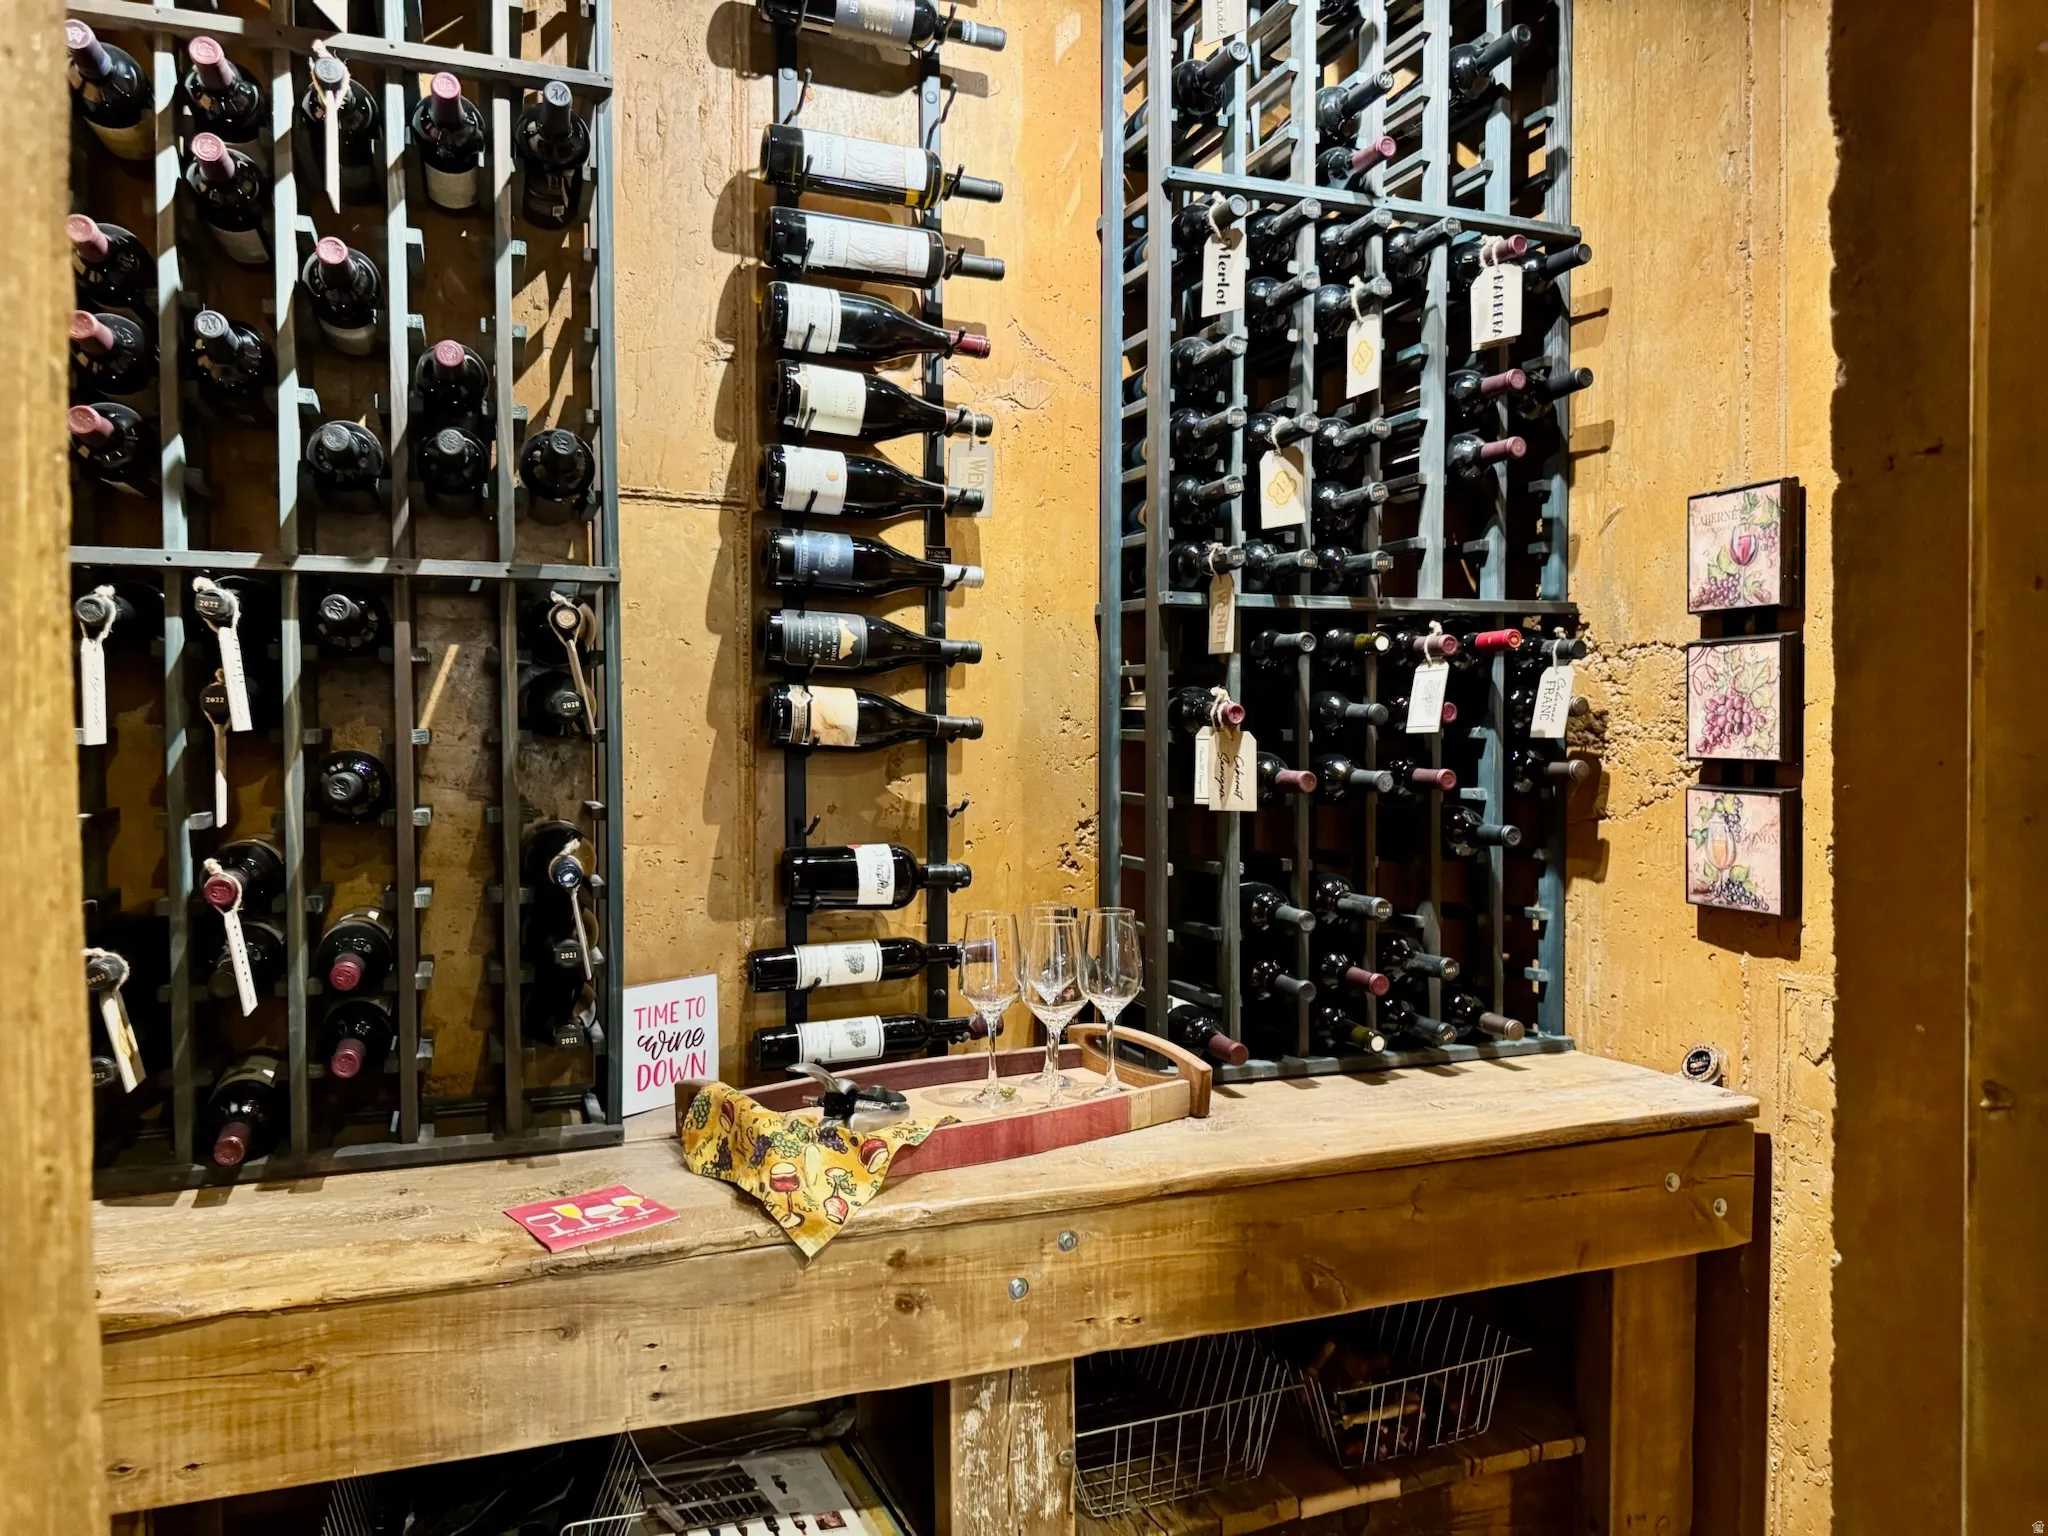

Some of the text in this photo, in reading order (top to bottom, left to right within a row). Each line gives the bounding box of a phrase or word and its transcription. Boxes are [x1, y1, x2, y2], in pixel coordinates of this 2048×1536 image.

[1216, 243, 1231, 306] Merlot
[1492, 274, 1504, 338] BARBERA
[199, 600, 219, 609] 2022
[205, 696, 225, 704] 2022
[562, 701, 580, 709] 2020
[1540, 680, 1556, 720] FRANC
[634, 995, 706, 1031] TIME TO
[561, 1037, 578, 1045] 2021
[637, 1027, 705, 1061] wine
[636, 1050, 707, 1093] DOWN
